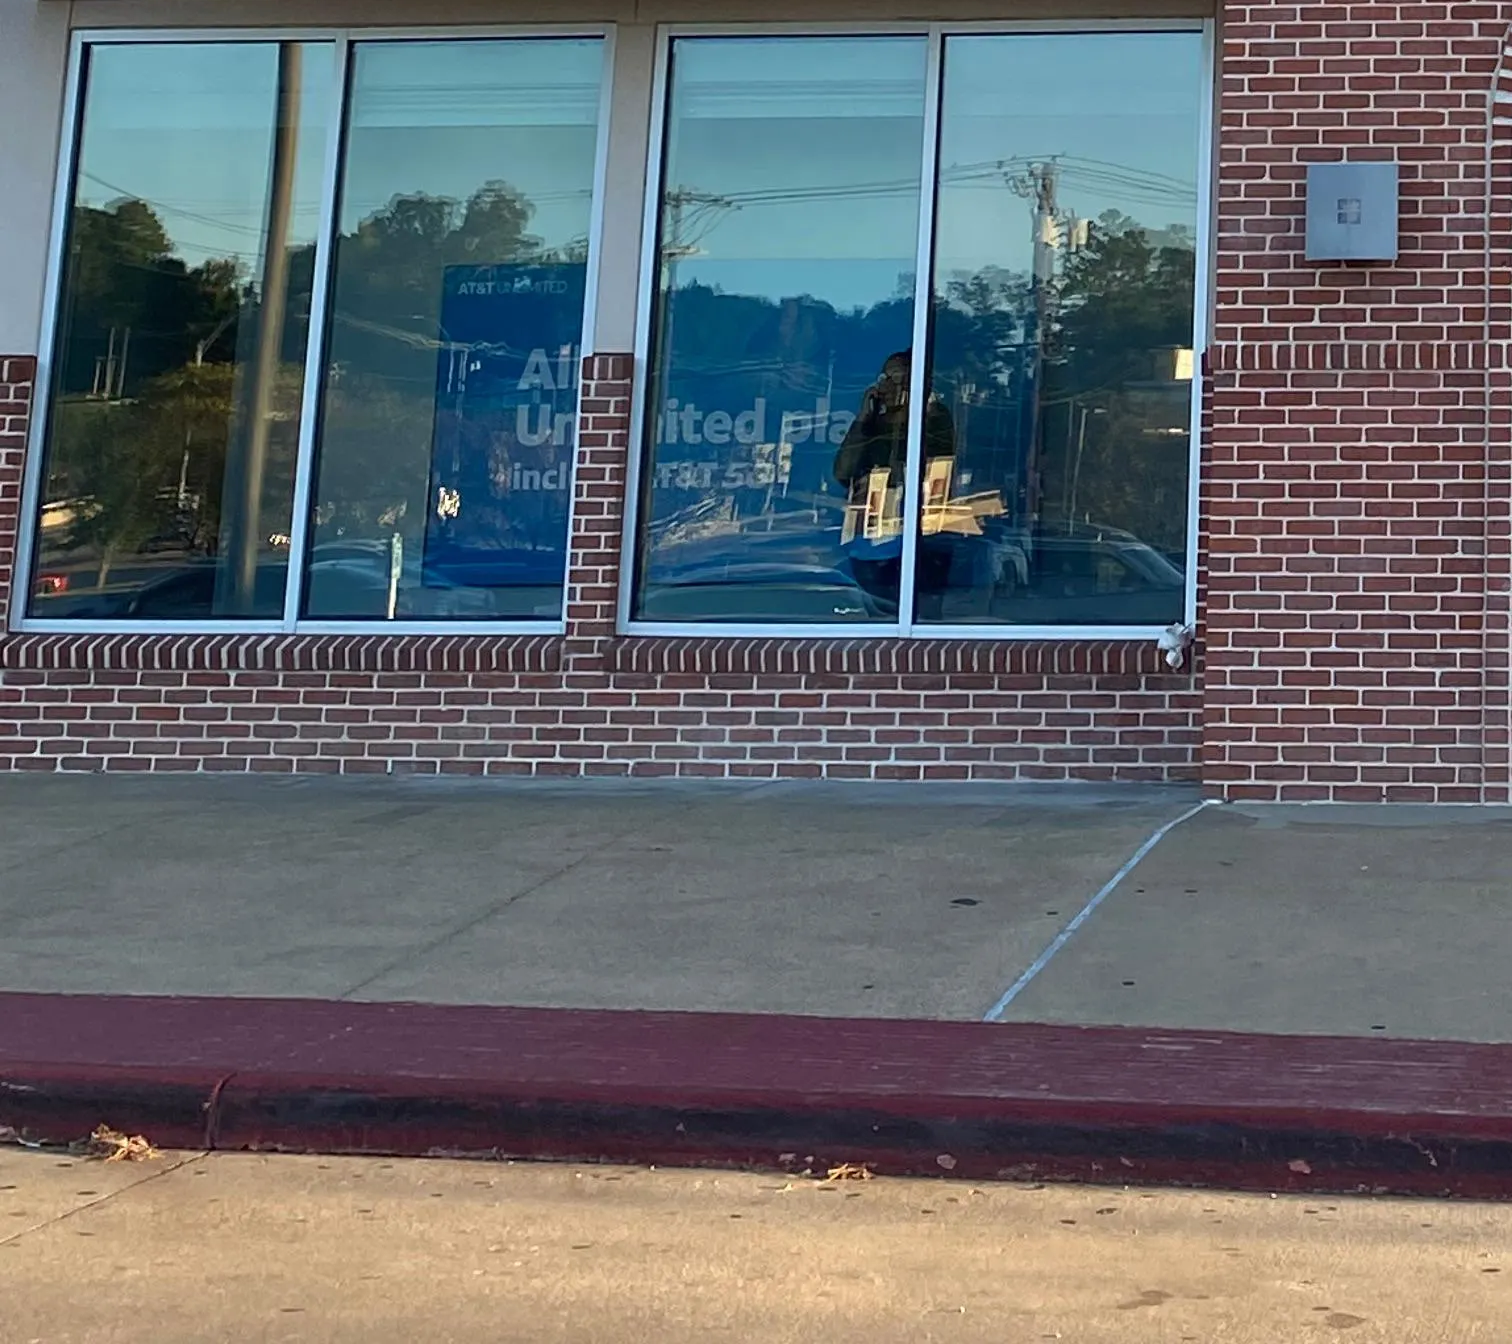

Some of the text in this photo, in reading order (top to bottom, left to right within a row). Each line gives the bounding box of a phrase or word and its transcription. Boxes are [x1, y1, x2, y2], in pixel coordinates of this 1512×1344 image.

[457, 282, 495, 295] AT&T
[781, 398, 858, 446] pla
[651, 462, 711, 491] T&T
